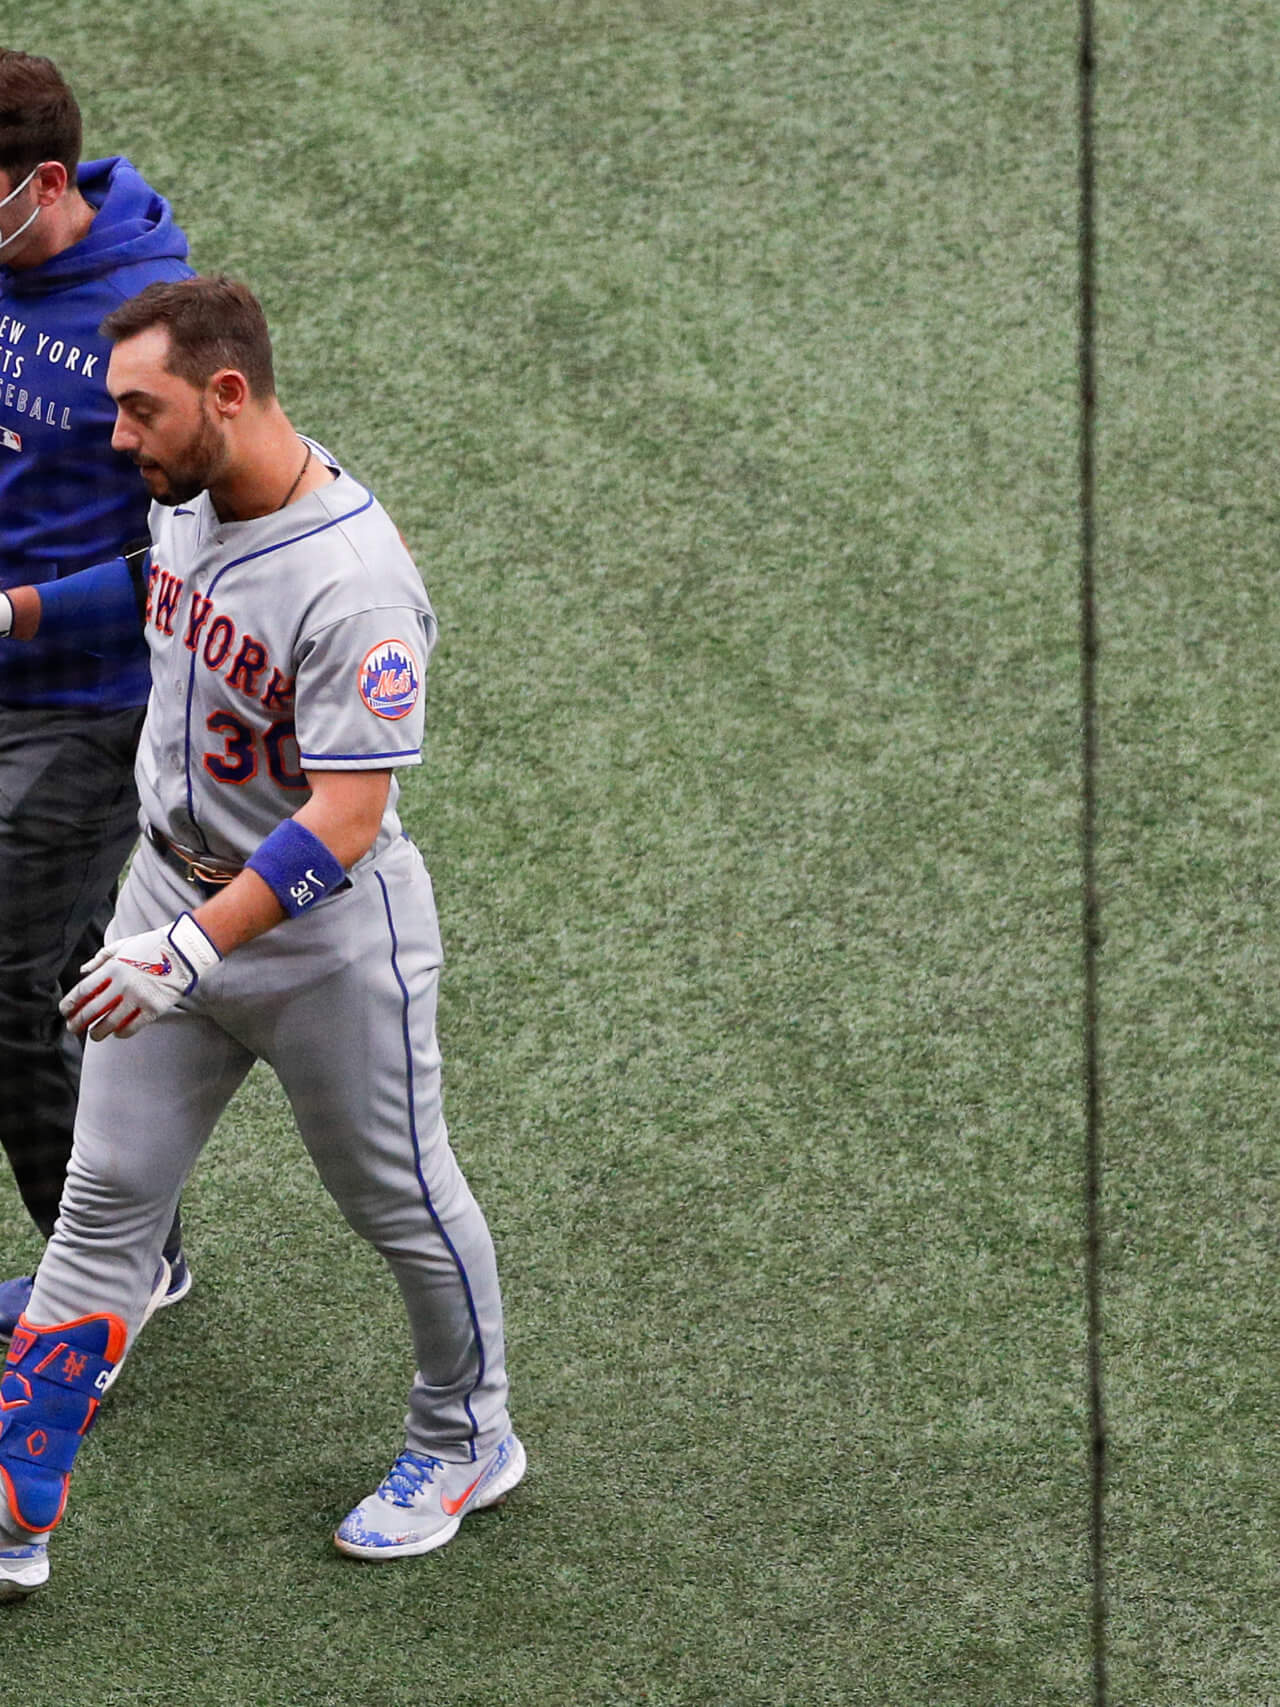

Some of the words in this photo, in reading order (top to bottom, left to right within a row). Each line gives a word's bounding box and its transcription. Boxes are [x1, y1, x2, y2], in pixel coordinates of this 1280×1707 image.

[35, 332, 99, 378] YORK
[184, 590, 297, 712] YORK
[370, 668, 412, 698] Mets
[204, 709, 313, 791] 30
[290, 880, 314, 906] 30
